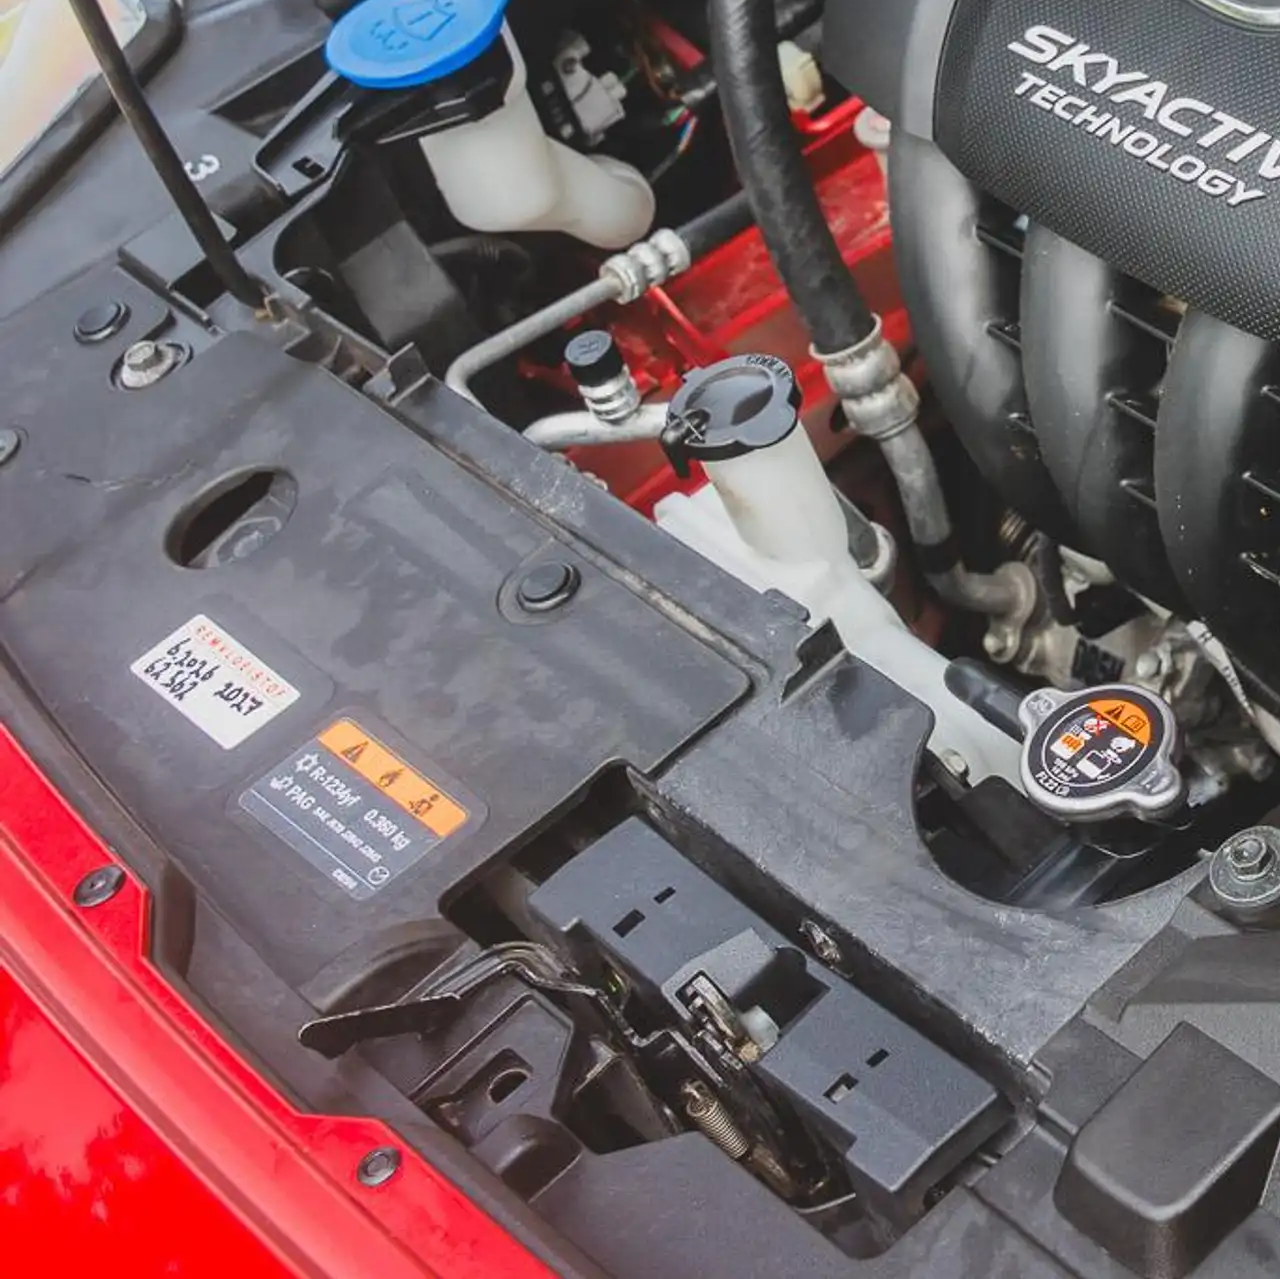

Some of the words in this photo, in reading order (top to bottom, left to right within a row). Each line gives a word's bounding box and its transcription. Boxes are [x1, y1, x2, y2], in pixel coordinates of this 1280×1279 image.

[1012, 71, 1266, 208] TECHNOLOGY
[285, 785, 316, 810] PAG
[391, 830, 412, 852] kg
